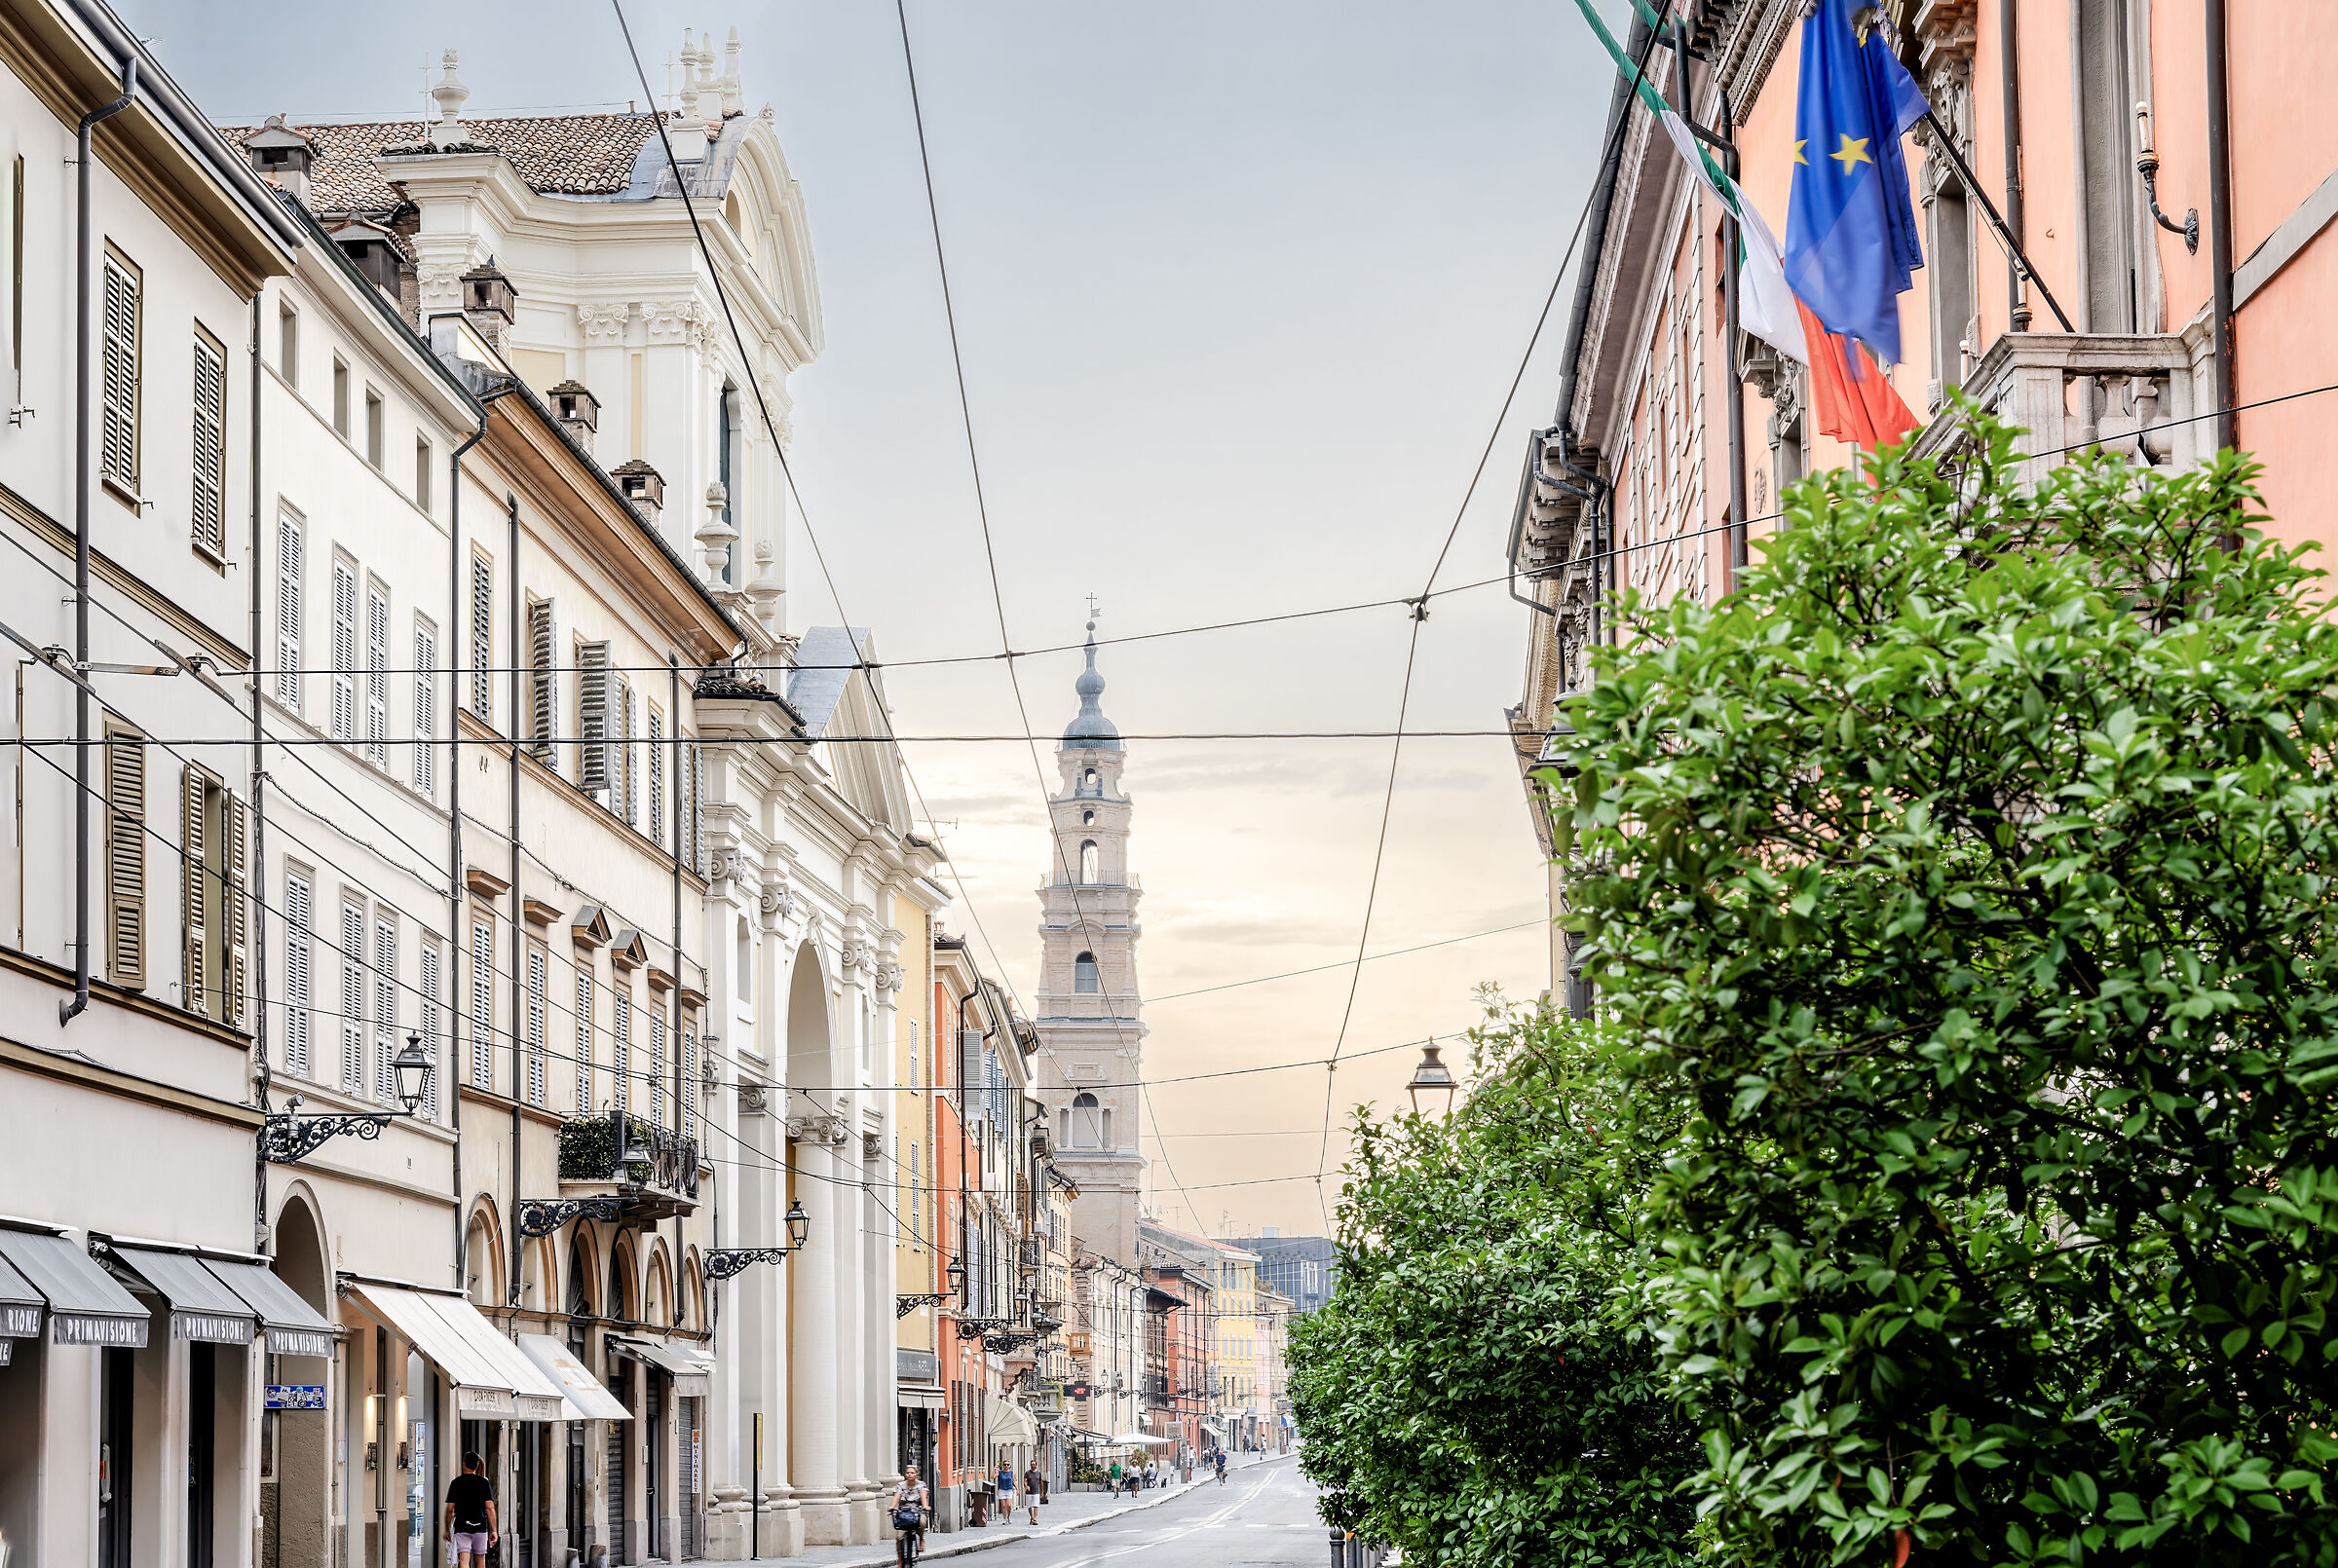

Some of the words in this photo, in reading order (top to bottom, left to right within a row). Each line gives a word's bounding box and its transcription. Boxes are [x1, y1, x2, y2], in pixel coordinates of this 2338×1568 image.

[67, 1319, 137, 1343] PRIMAVISIONE
[186, 1317, 244, 1340] PRIMAVISIONE
[275, 1331, 325, 1354] PRIMAVISIONE
